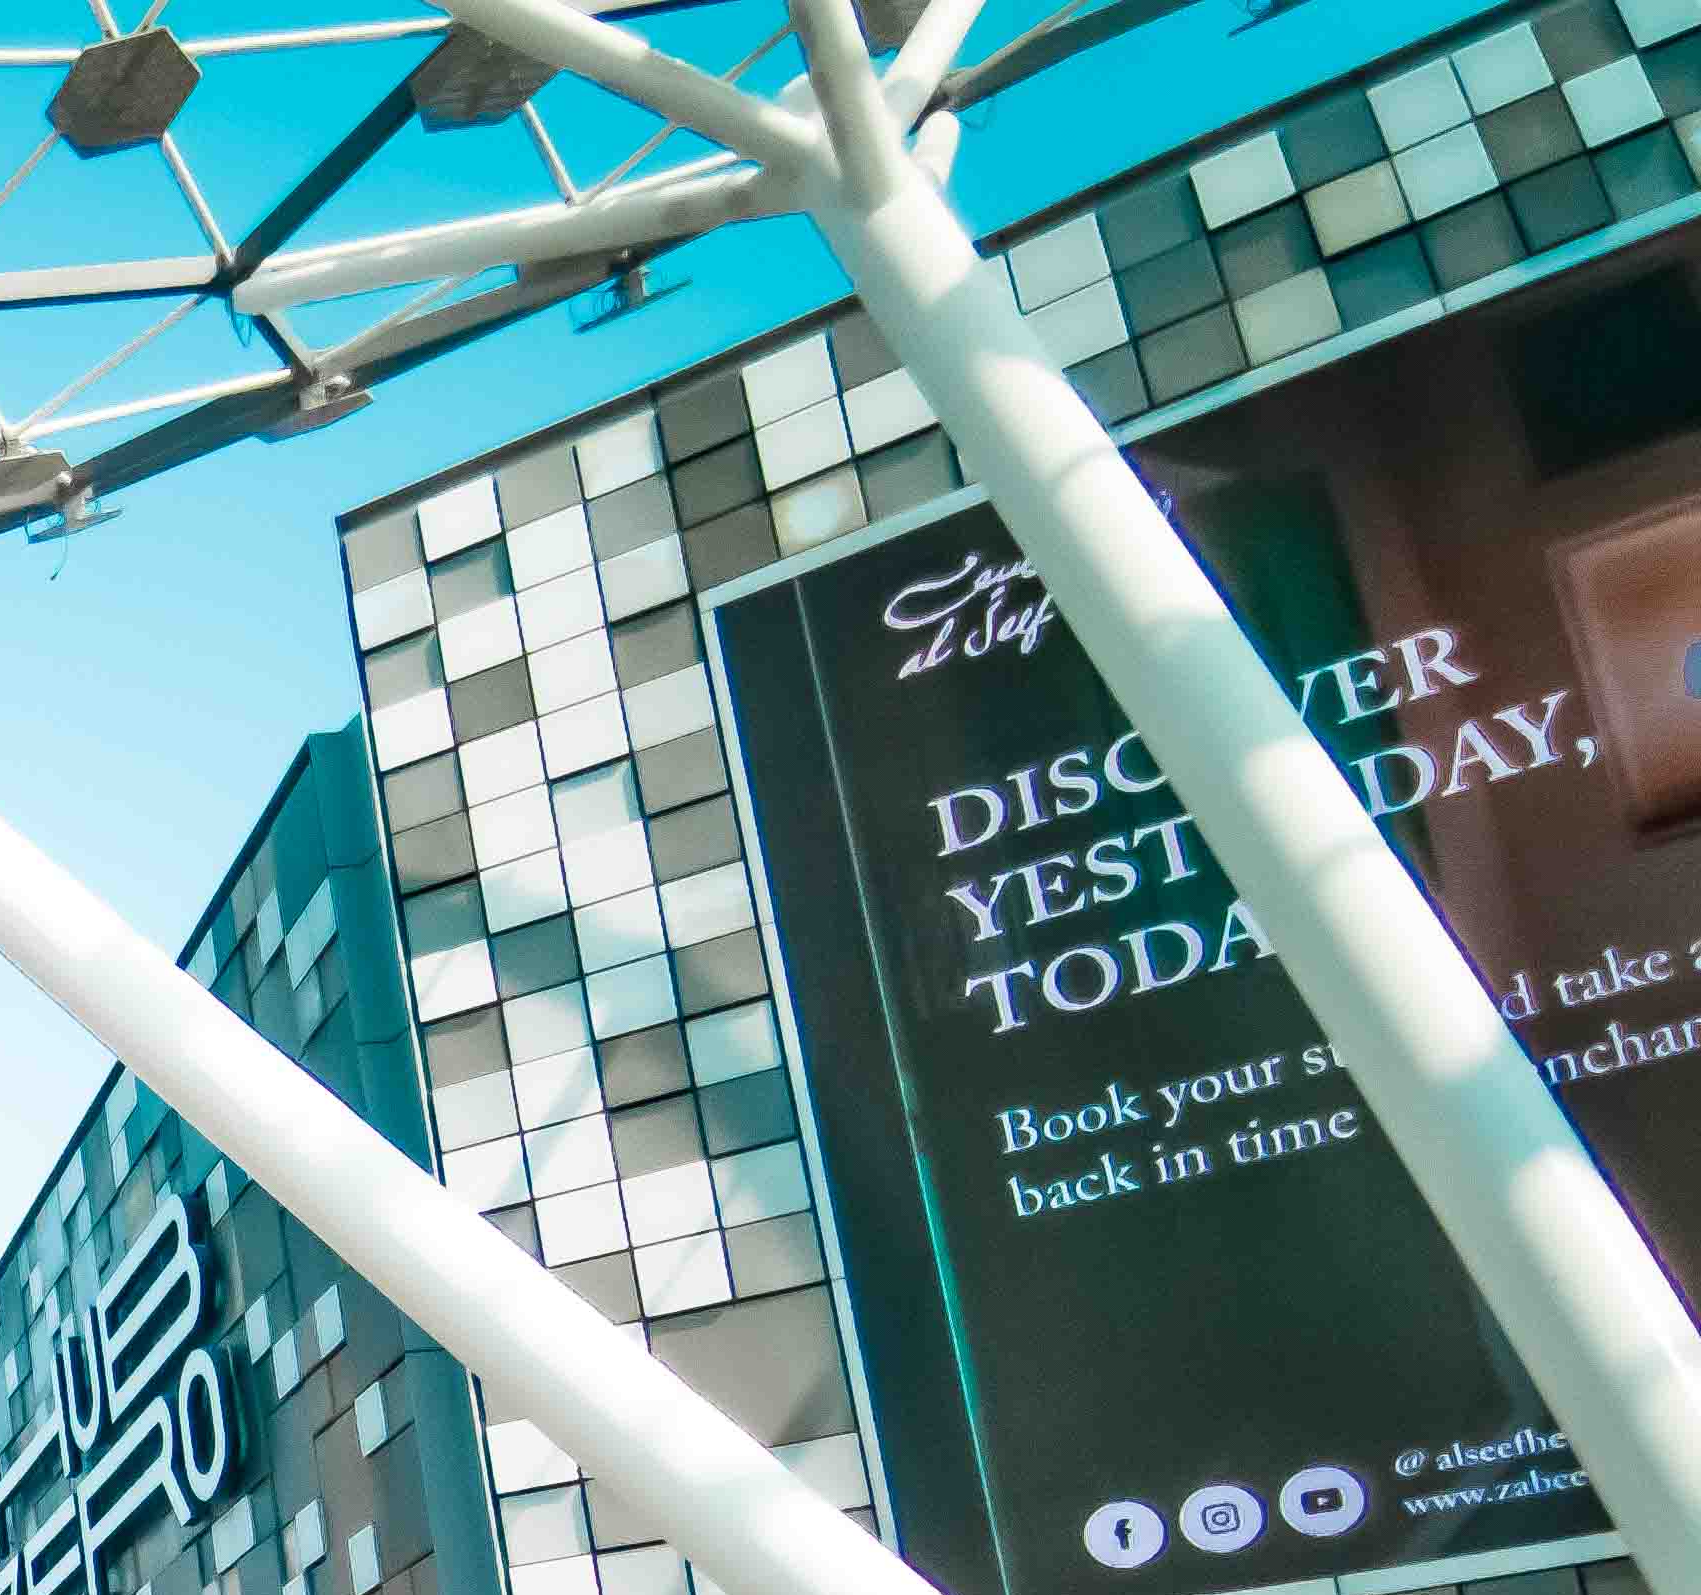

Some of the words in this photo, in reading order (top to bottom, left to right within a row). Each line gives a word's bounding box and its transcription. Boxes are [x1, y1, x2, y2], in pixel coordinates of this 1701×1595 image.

[1554, 946, 1671, 1007] take
[997, 1083, 1150, 1154] Book
[1159, 1053, 1283, 1127] your
[1007, 1157, 1141, 1218] back
[1153, 1143, 1210, 1186] in
[1227, 1107, 1360, 1166] time
